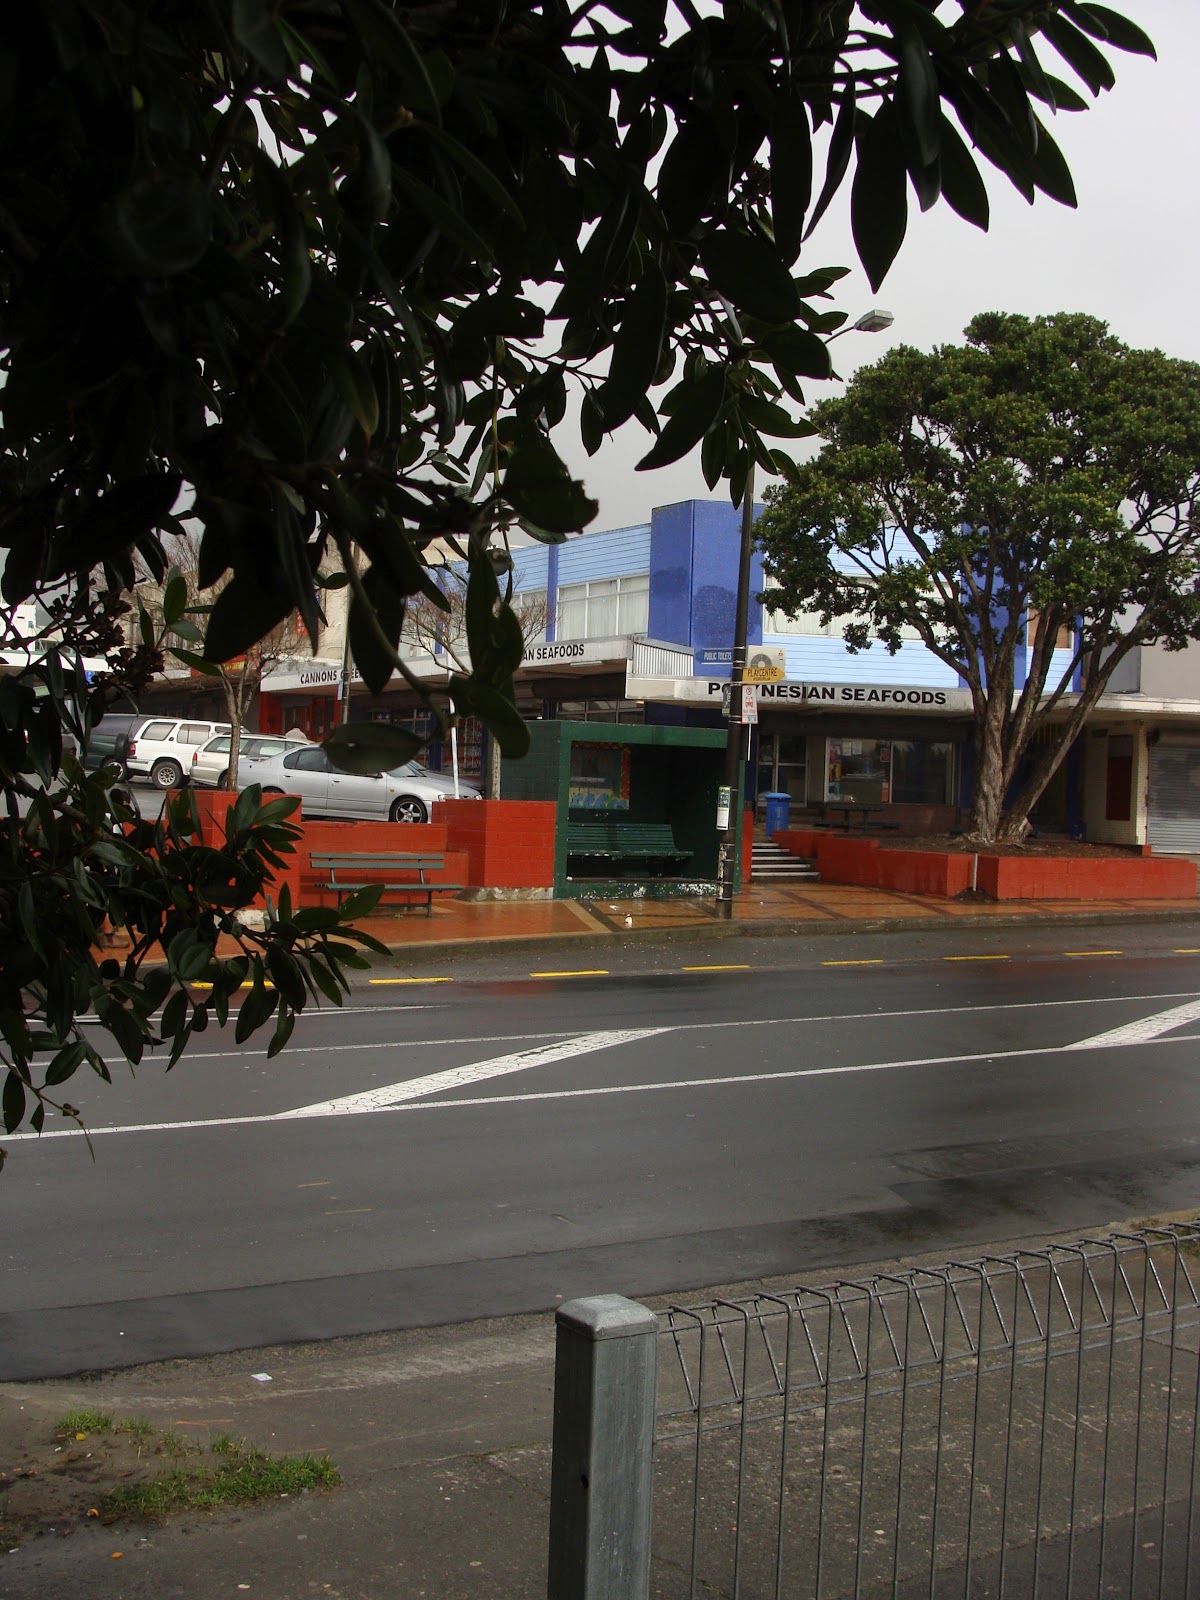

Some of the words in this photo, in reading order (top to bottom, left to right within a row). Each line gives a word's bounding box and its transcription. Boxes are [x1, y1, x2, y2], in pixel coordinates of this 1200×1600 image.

[536, 644, 585, 659] SEAFOODS
[703, 652, 717, 661] PUBLIC
[717, 652, 732, 661] TOILETS
[300, 670, 338, 684] CANNONS
[747, 667, 778, 677] PLAYCENTRE
[841, 687, 947, 705] SEAFOODS
